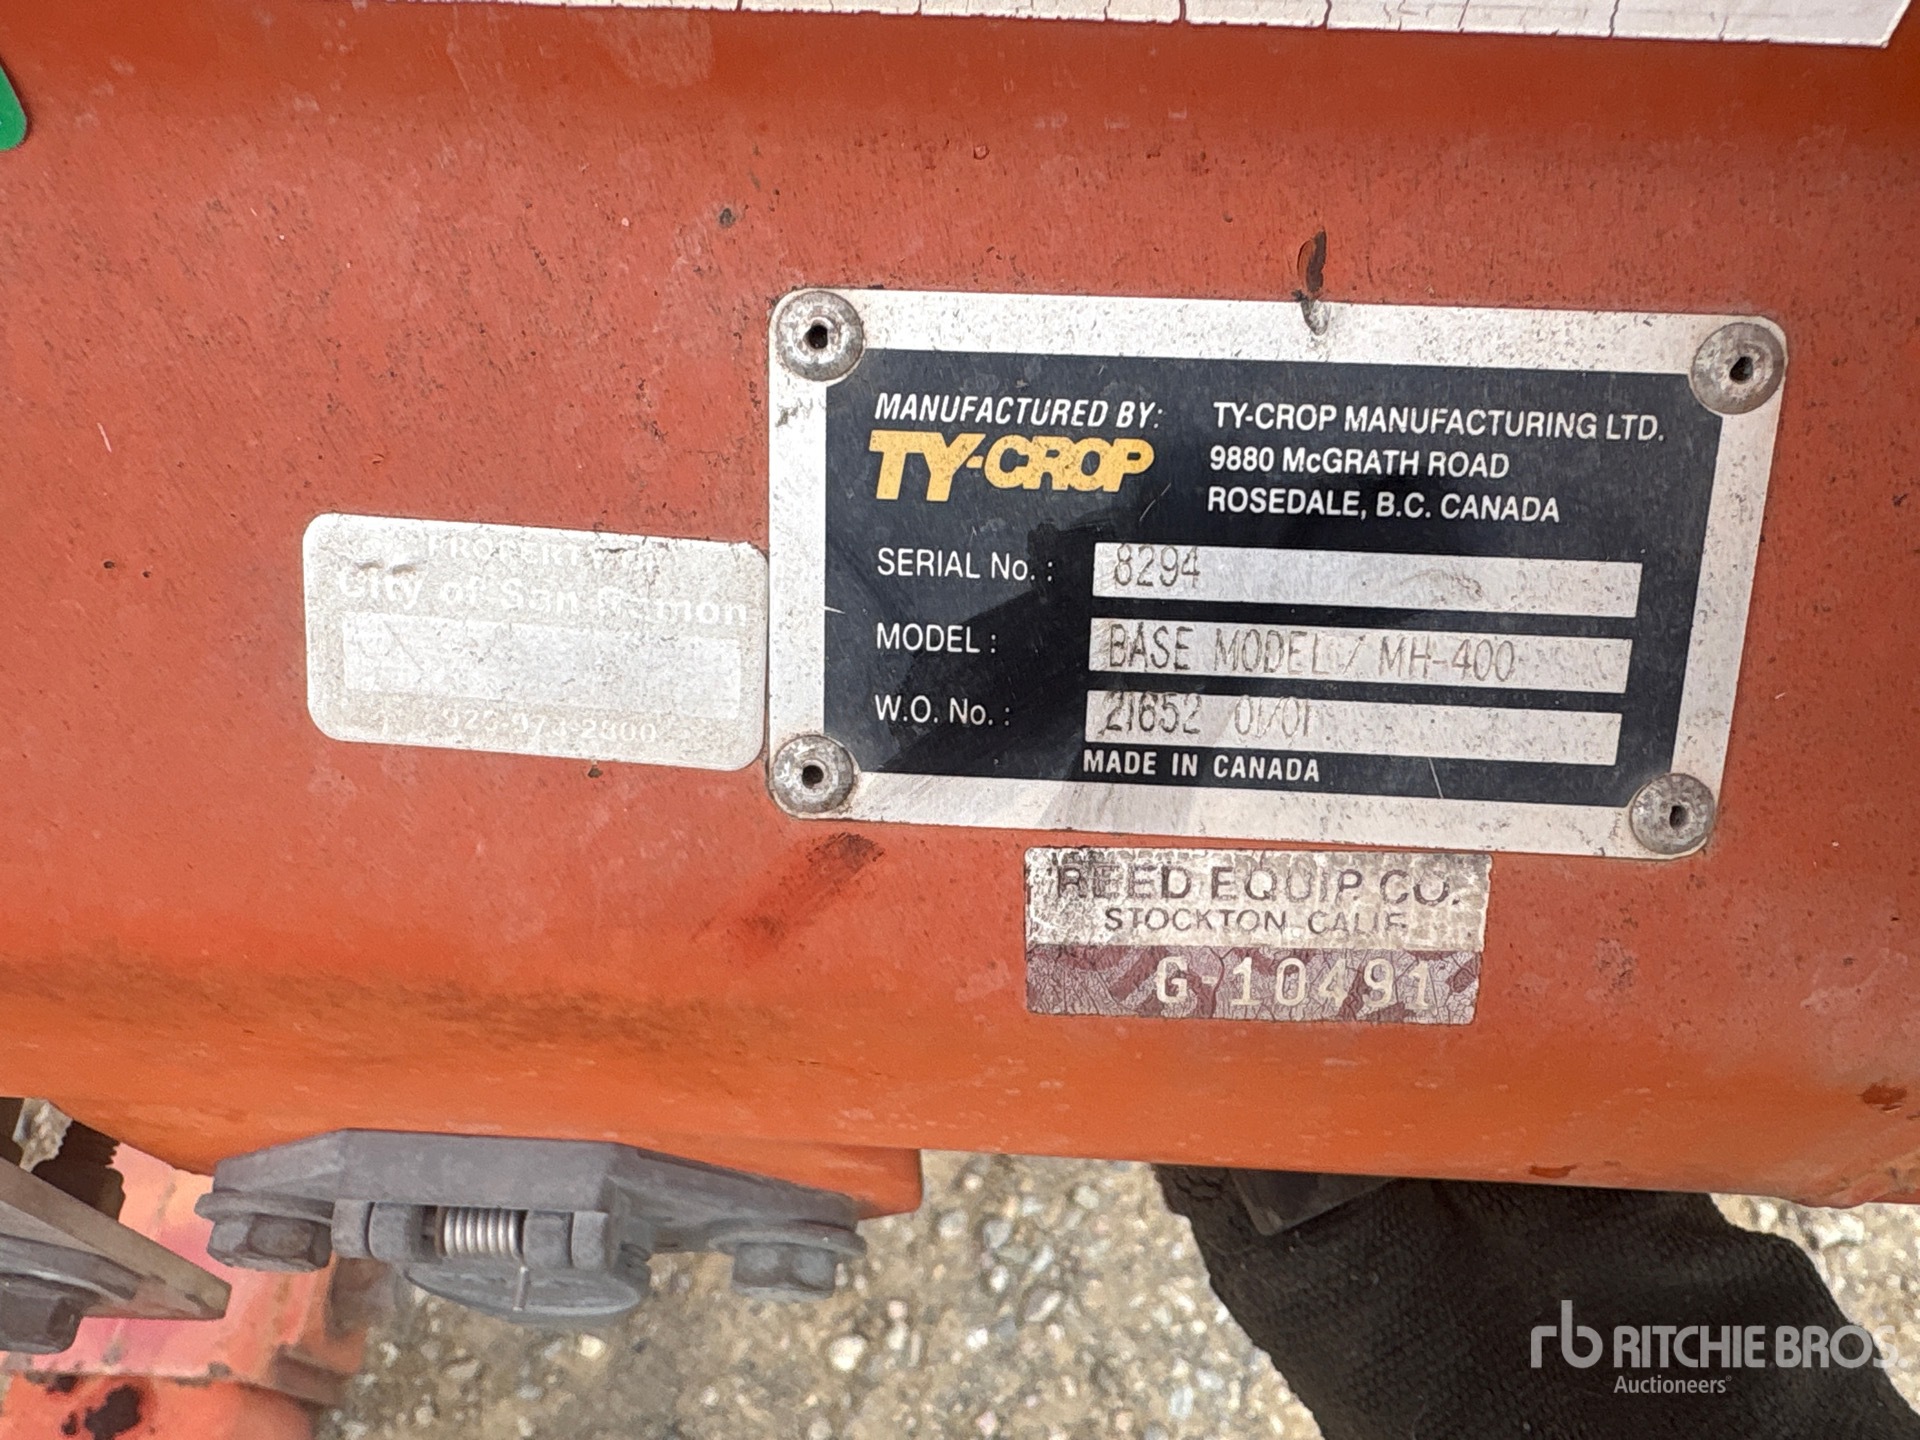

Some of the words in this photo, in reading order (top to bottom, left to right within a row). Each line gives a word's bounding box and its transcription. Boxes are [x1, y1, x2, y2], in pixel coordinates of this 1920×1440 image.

[874, 392, 1108, 428] MANUFACTURED
[1115, 401, 1164, 429] BY:
[1213, 402, 1338, 431] TY-CROP
[1344, 407, 1599, 439] MANUFACTURING
[1605, 415, 1666, 442] LTD.
[868, 429, 1155, 502] TY-CROP
[1209, 446, 1276, 472] 9880
[1282, 448, 1420, 476] McGRATH
[1427, 453, 1510, 479] ROAD
[1207, 487, 1368, 520] ROSEDALE,
[1376, 492, 1432, 518] B.C.
[1440, 494, 1560, 523] CANADA
[877, 547, 981, 579] SERIAL
[990, 552, 1036, 581] No.
[1112, 544, 1200, 589] 8294
[439, 573, 487, 606] of
[876, 622, 980, 654] MODEL
[1108, 622, 1195, 671] BASE
[1213, 626, 1330, 676] MODEL
[1378, 636, 1516, 682] MH-400
[875, 694, 939, 724] W.O.
[949, 697, 994, 727] No.
[1083, 750, 1157, 775] MADE
[1172, 753, 1198, 777] IN
[1213, 755, 1321, 783] CANADA
[1056, 862, 1193, 899] REED
[1104, 906, 1287, 933] STOCKTON
